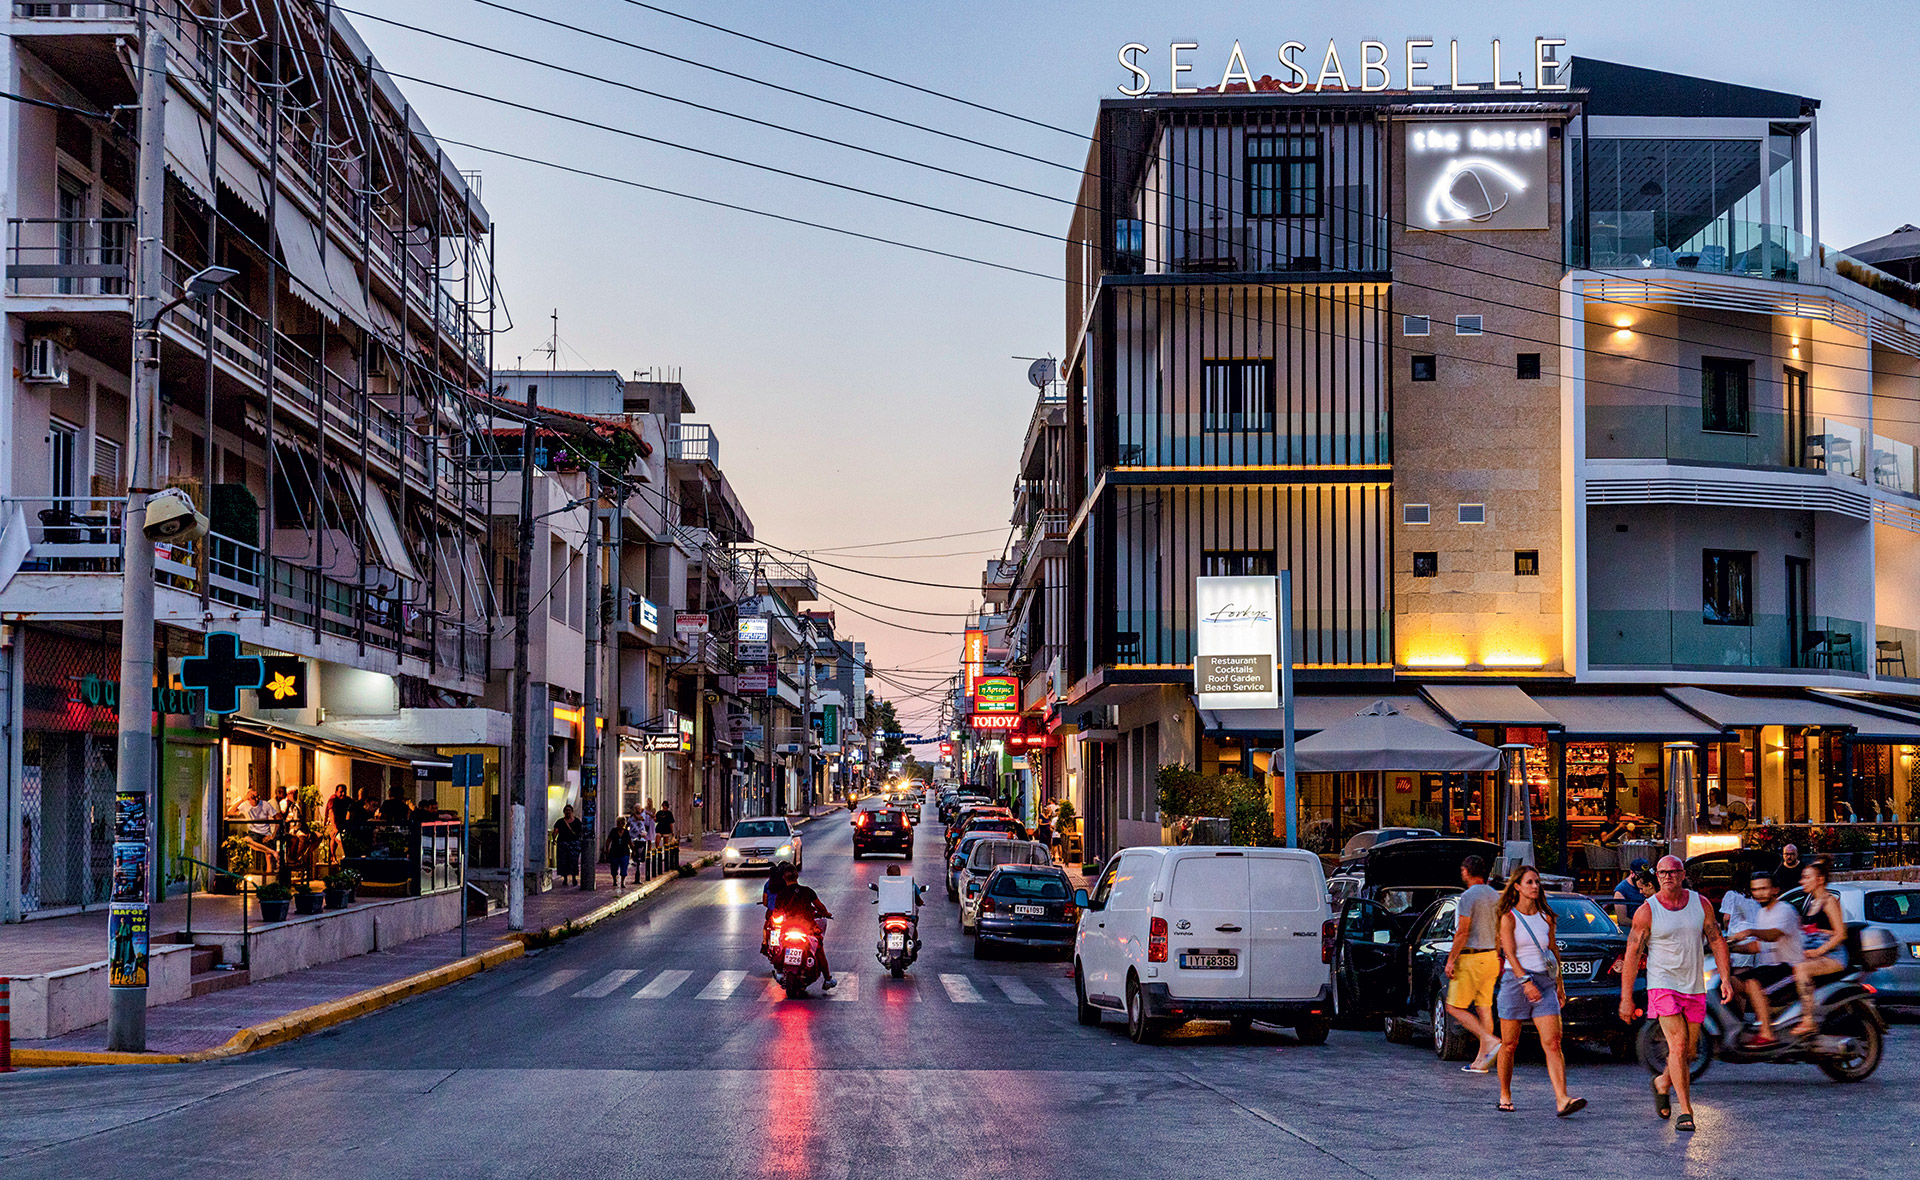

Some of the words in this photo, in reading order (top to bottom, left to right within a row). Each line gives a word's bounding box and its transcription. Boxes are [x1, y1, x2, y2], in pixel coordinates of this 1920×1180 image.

[1413, 129, 1459, 149] the
[1471, 127, 1542, 148] hotel
[1230, 674, 1260, 682] Garden
[1233, 683, 1264, 691] Service
